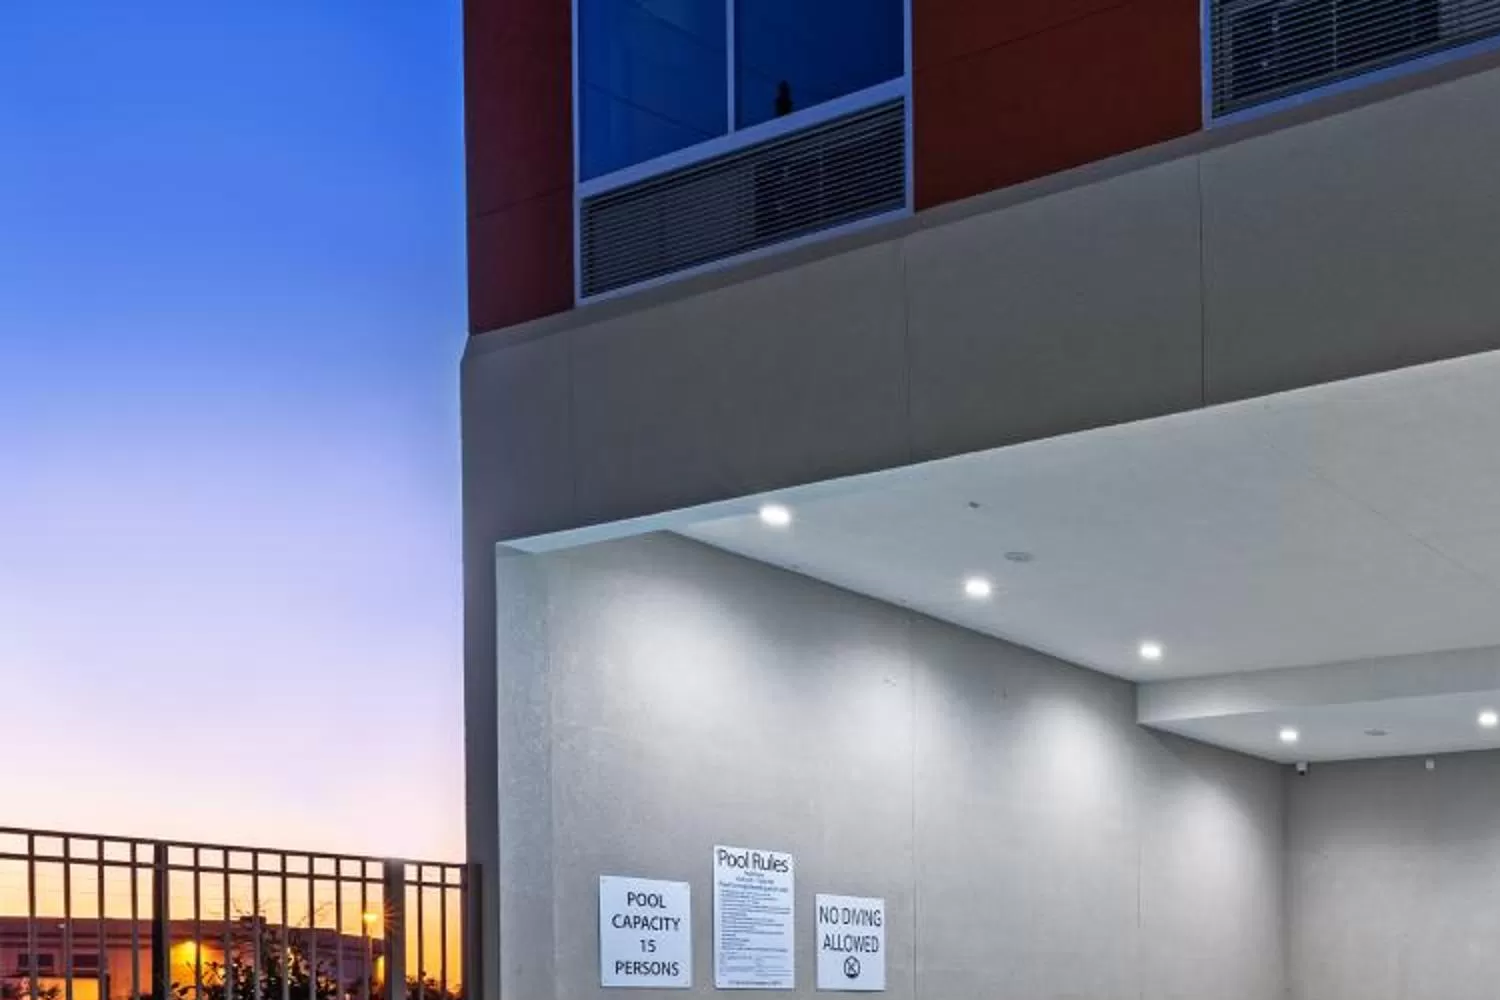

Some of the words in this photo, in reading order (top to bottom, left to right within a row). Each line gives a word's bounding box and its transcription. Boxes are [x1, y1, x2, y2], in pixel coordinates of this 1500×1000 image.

[718, 849, 749, 869] Pool
[753, 852, 789, 873] Rules
[627, 891, 667, 909] POOL
[611, 913, 681, 932] CAPACITY
[819, 905, 839, 924] NO
[842, 907, 882, 927] DIVING
[640, 939, 657, 953] 15
[823, 933, 879, 953] ALLOWED
[615, 960, 680, 977] PERSONS
